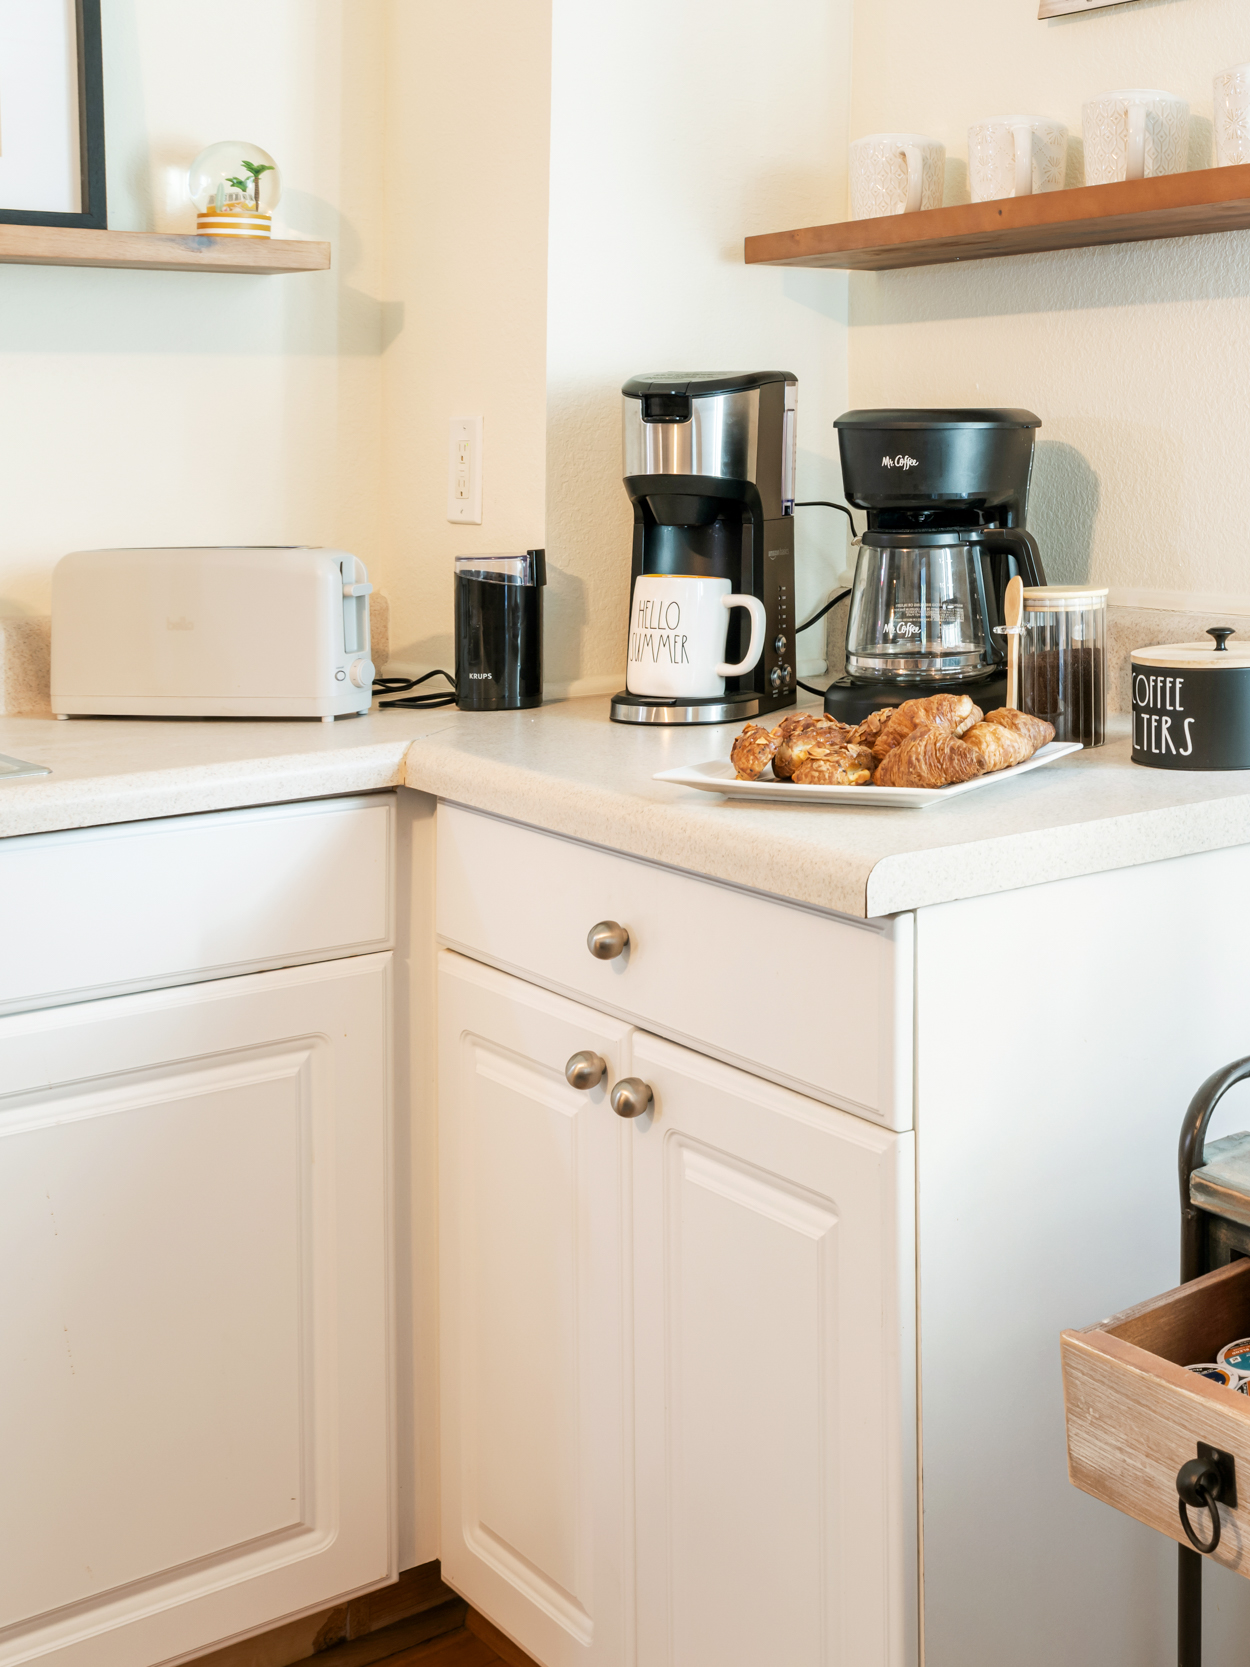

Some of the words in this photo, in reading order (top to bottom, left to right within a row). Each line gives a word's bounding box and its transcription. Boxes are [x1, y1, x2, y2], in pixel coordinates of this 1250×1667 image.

[882, 456, 894, 469] Mr.
[895, 455, 919, 470] Coffee
[638, 600, 680, 630] HELLO
[896, 622, 922, 638] Coffee
[630, 633, 689, 664] SUMMER
[1134, 711, 1195, 756] LTERS
